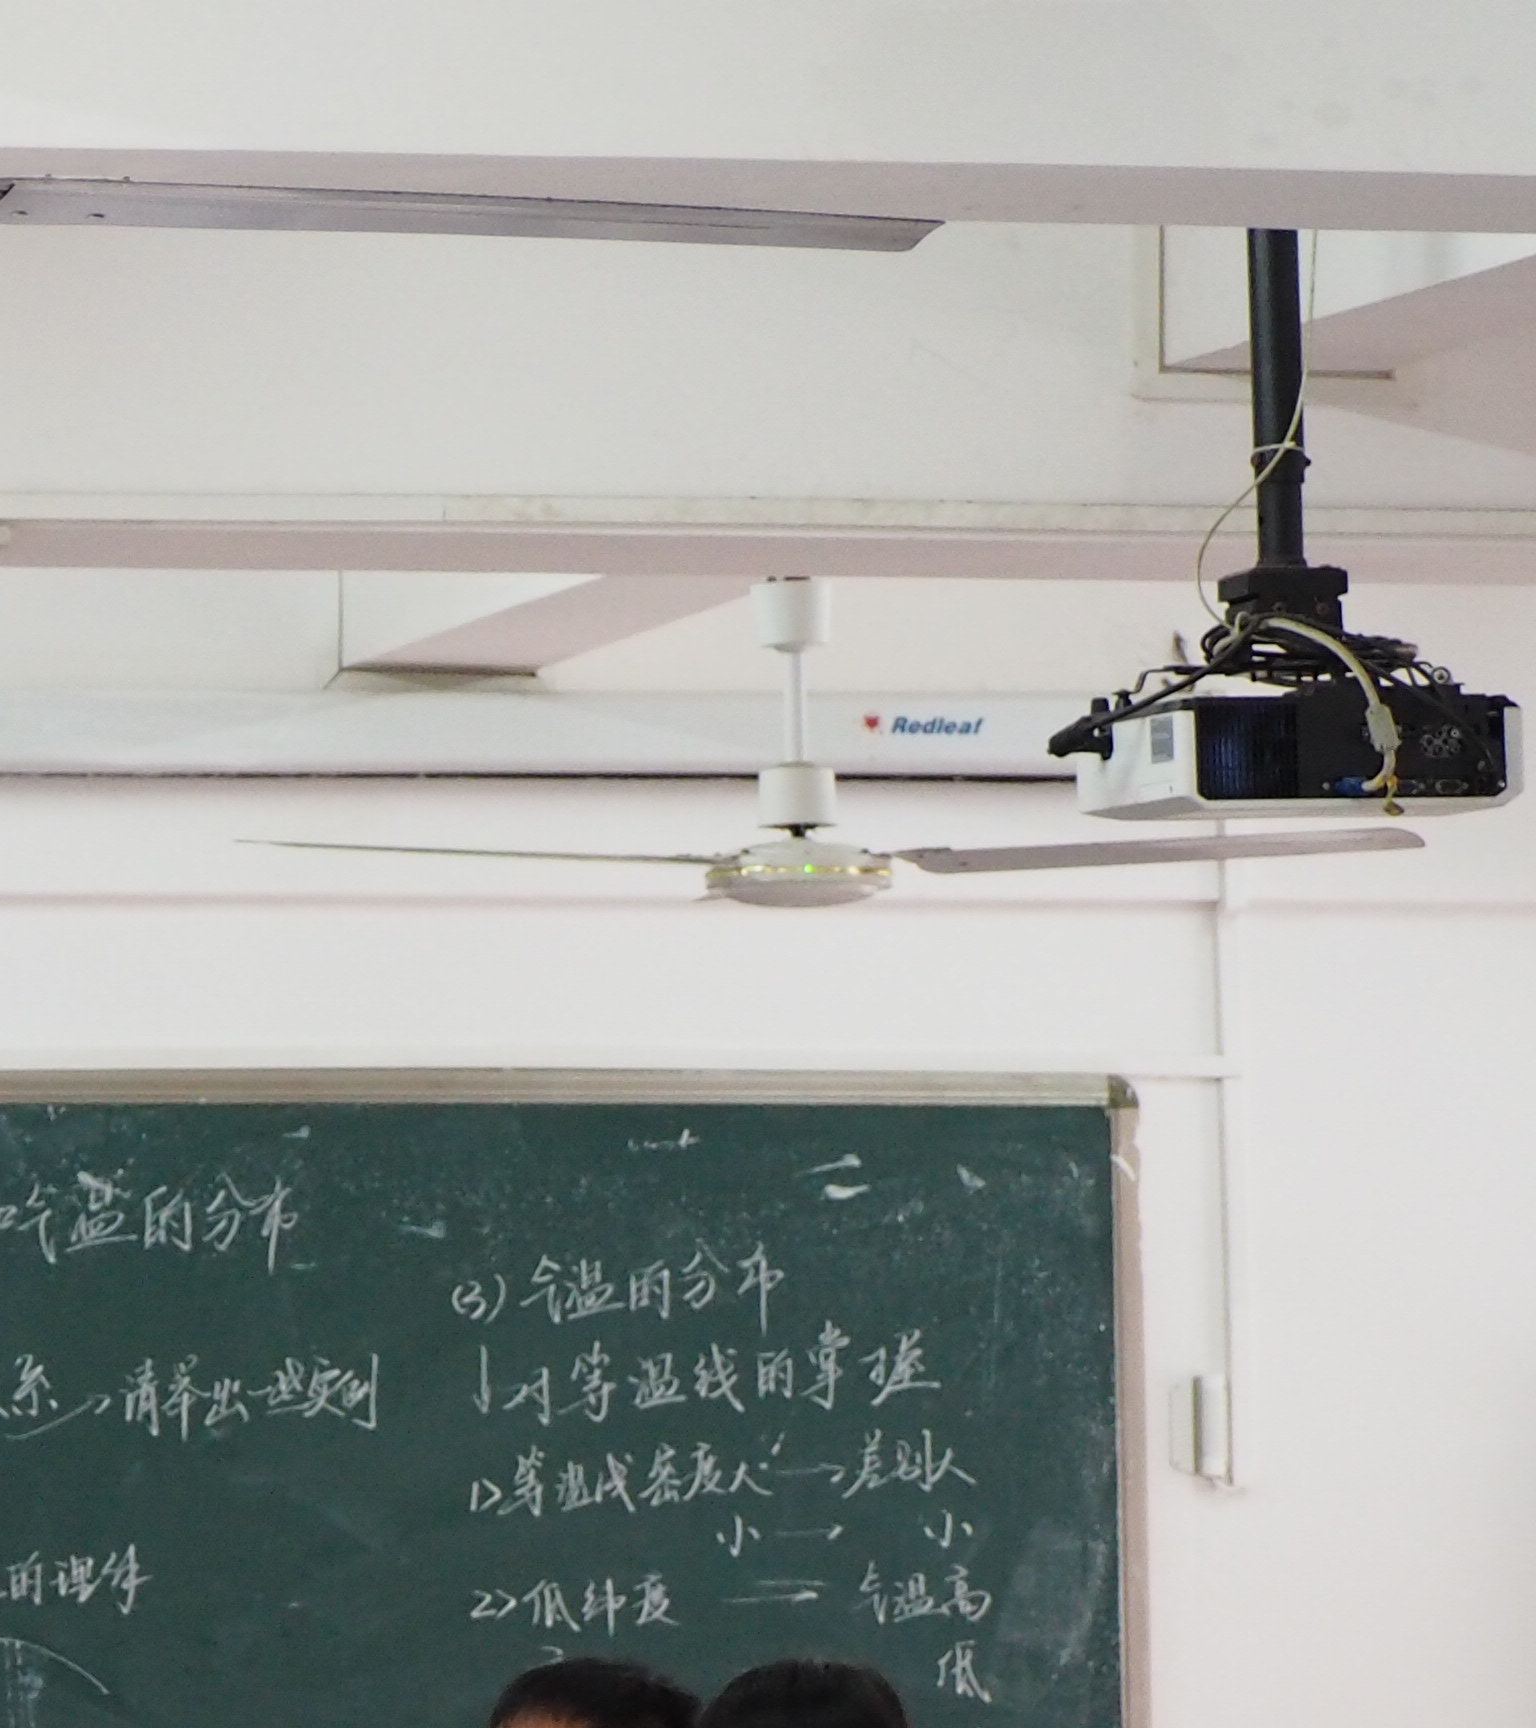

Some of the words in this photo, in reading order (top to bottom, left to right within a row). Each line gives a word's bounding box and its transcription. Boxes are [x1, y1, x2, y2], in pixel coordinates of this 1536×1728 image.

[891, 715, 984, 736] Redleaf
[716, 1514, 761, 1558] 小
[924, 1508, 974, 1548] 小
